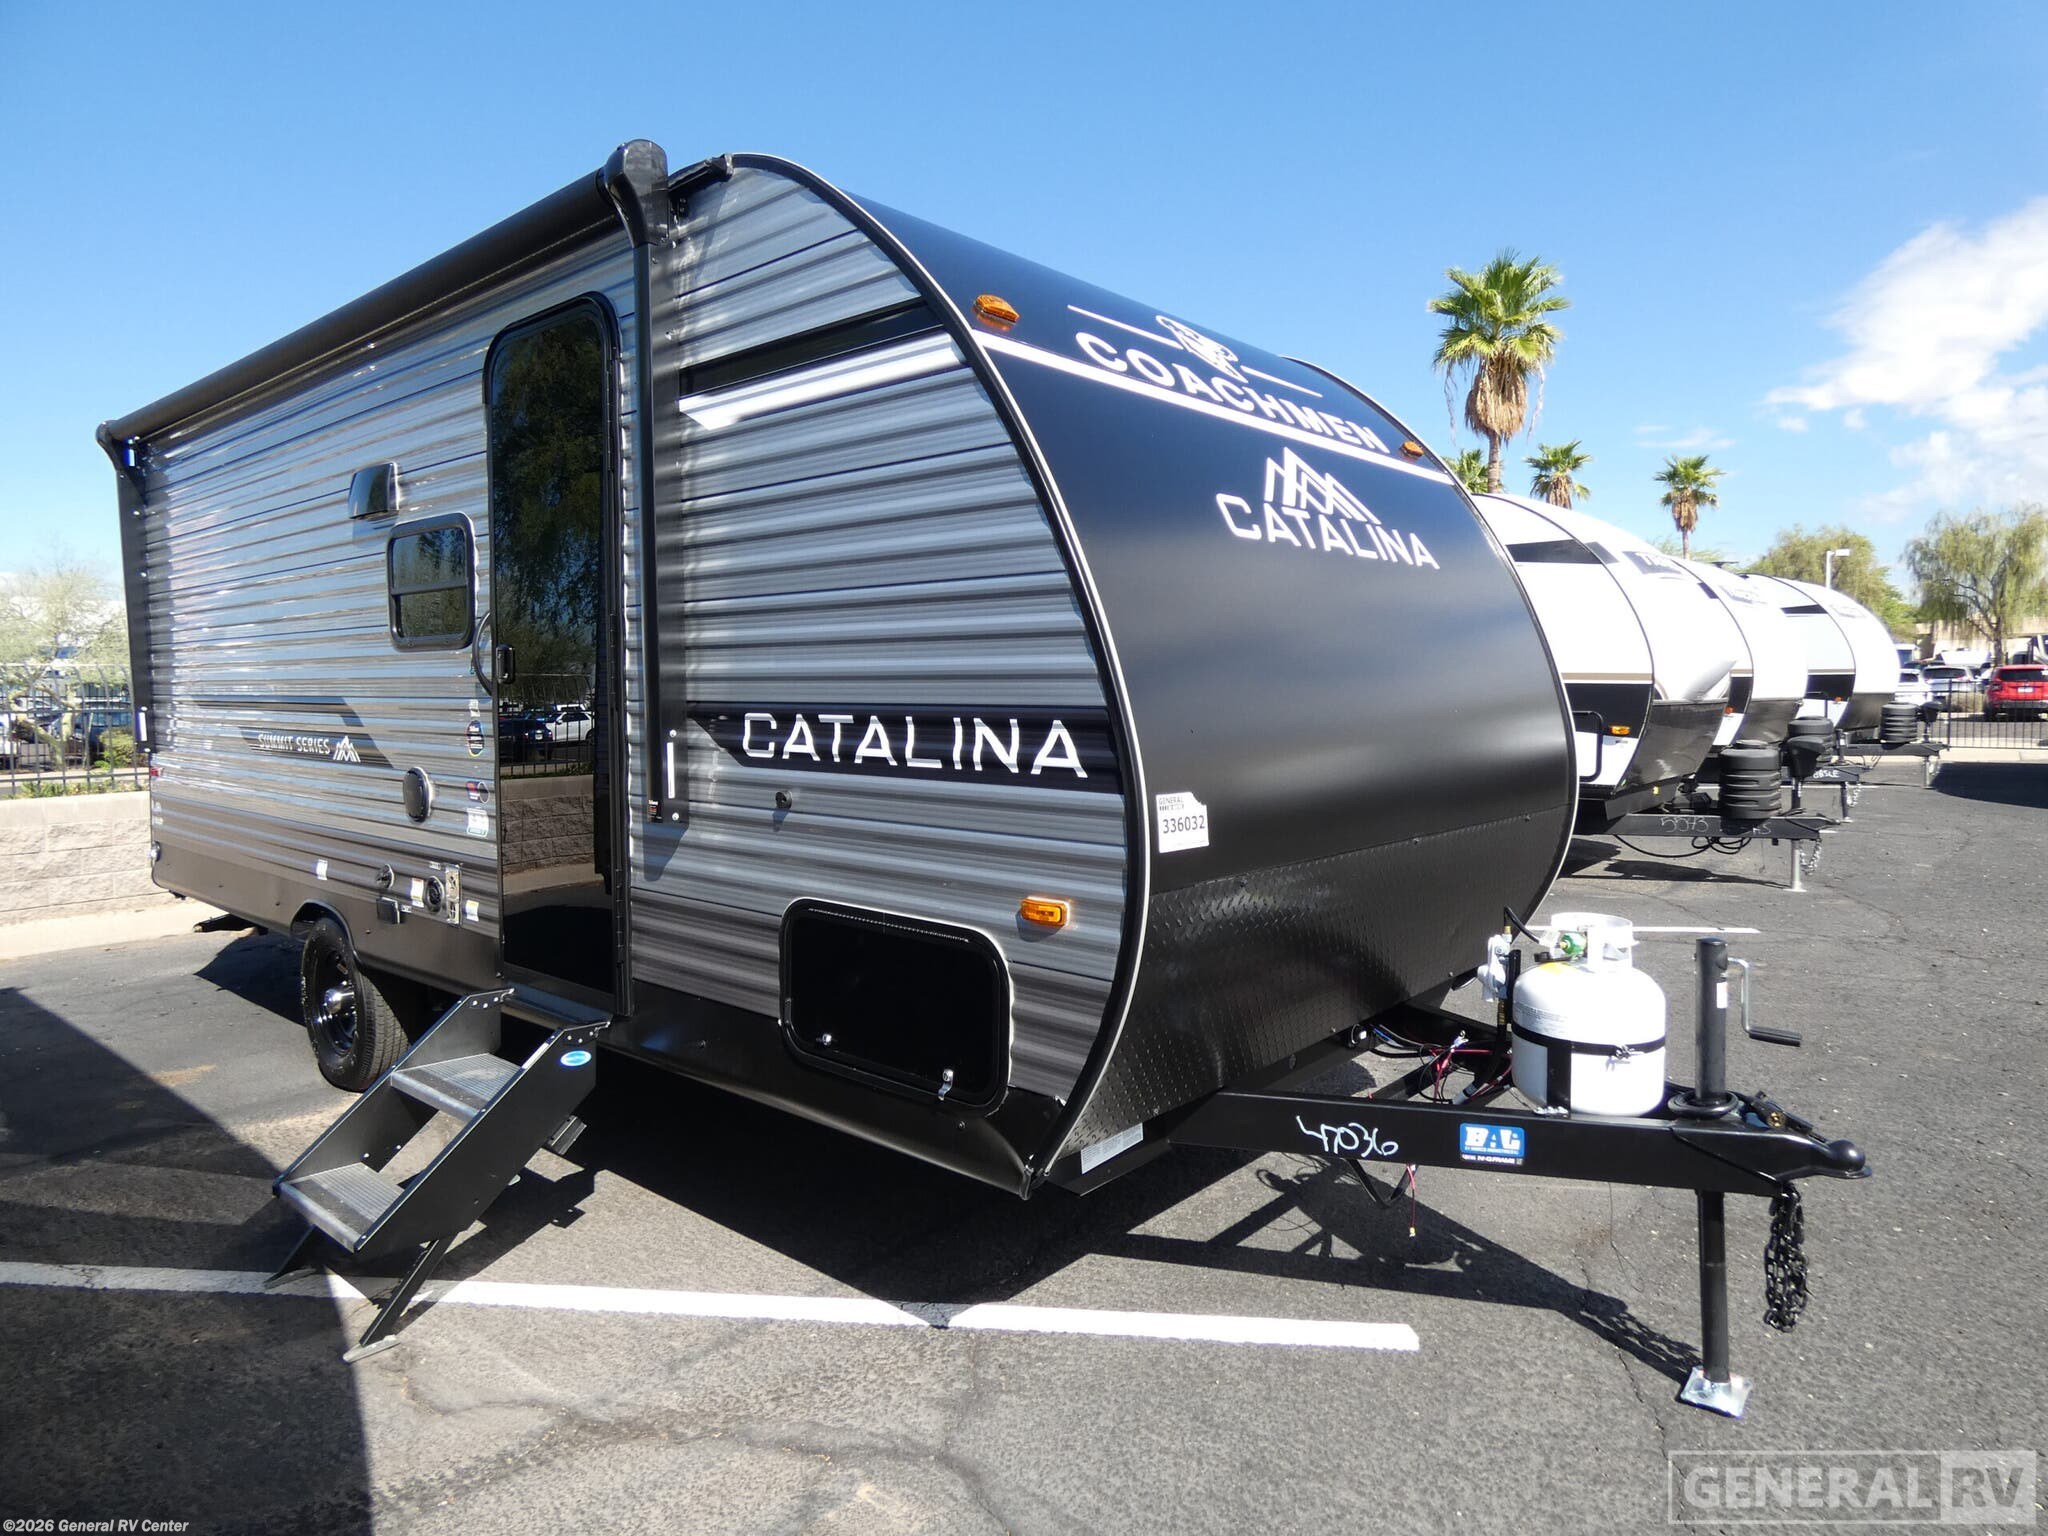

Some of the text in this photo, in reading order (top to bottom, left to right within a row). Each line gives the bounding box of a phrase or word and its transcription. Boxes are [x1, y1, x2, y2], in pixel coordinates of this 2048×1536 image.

[1076, 332, 1390, 453] COACHMEN
[1216, 493, 1440, 569] CATALINA
[258, 733, 331, 755] SUMMIT SERIES
[742, 713, 1088, 778] CATALINA
[1163, 815, 1205, 834] 336032
